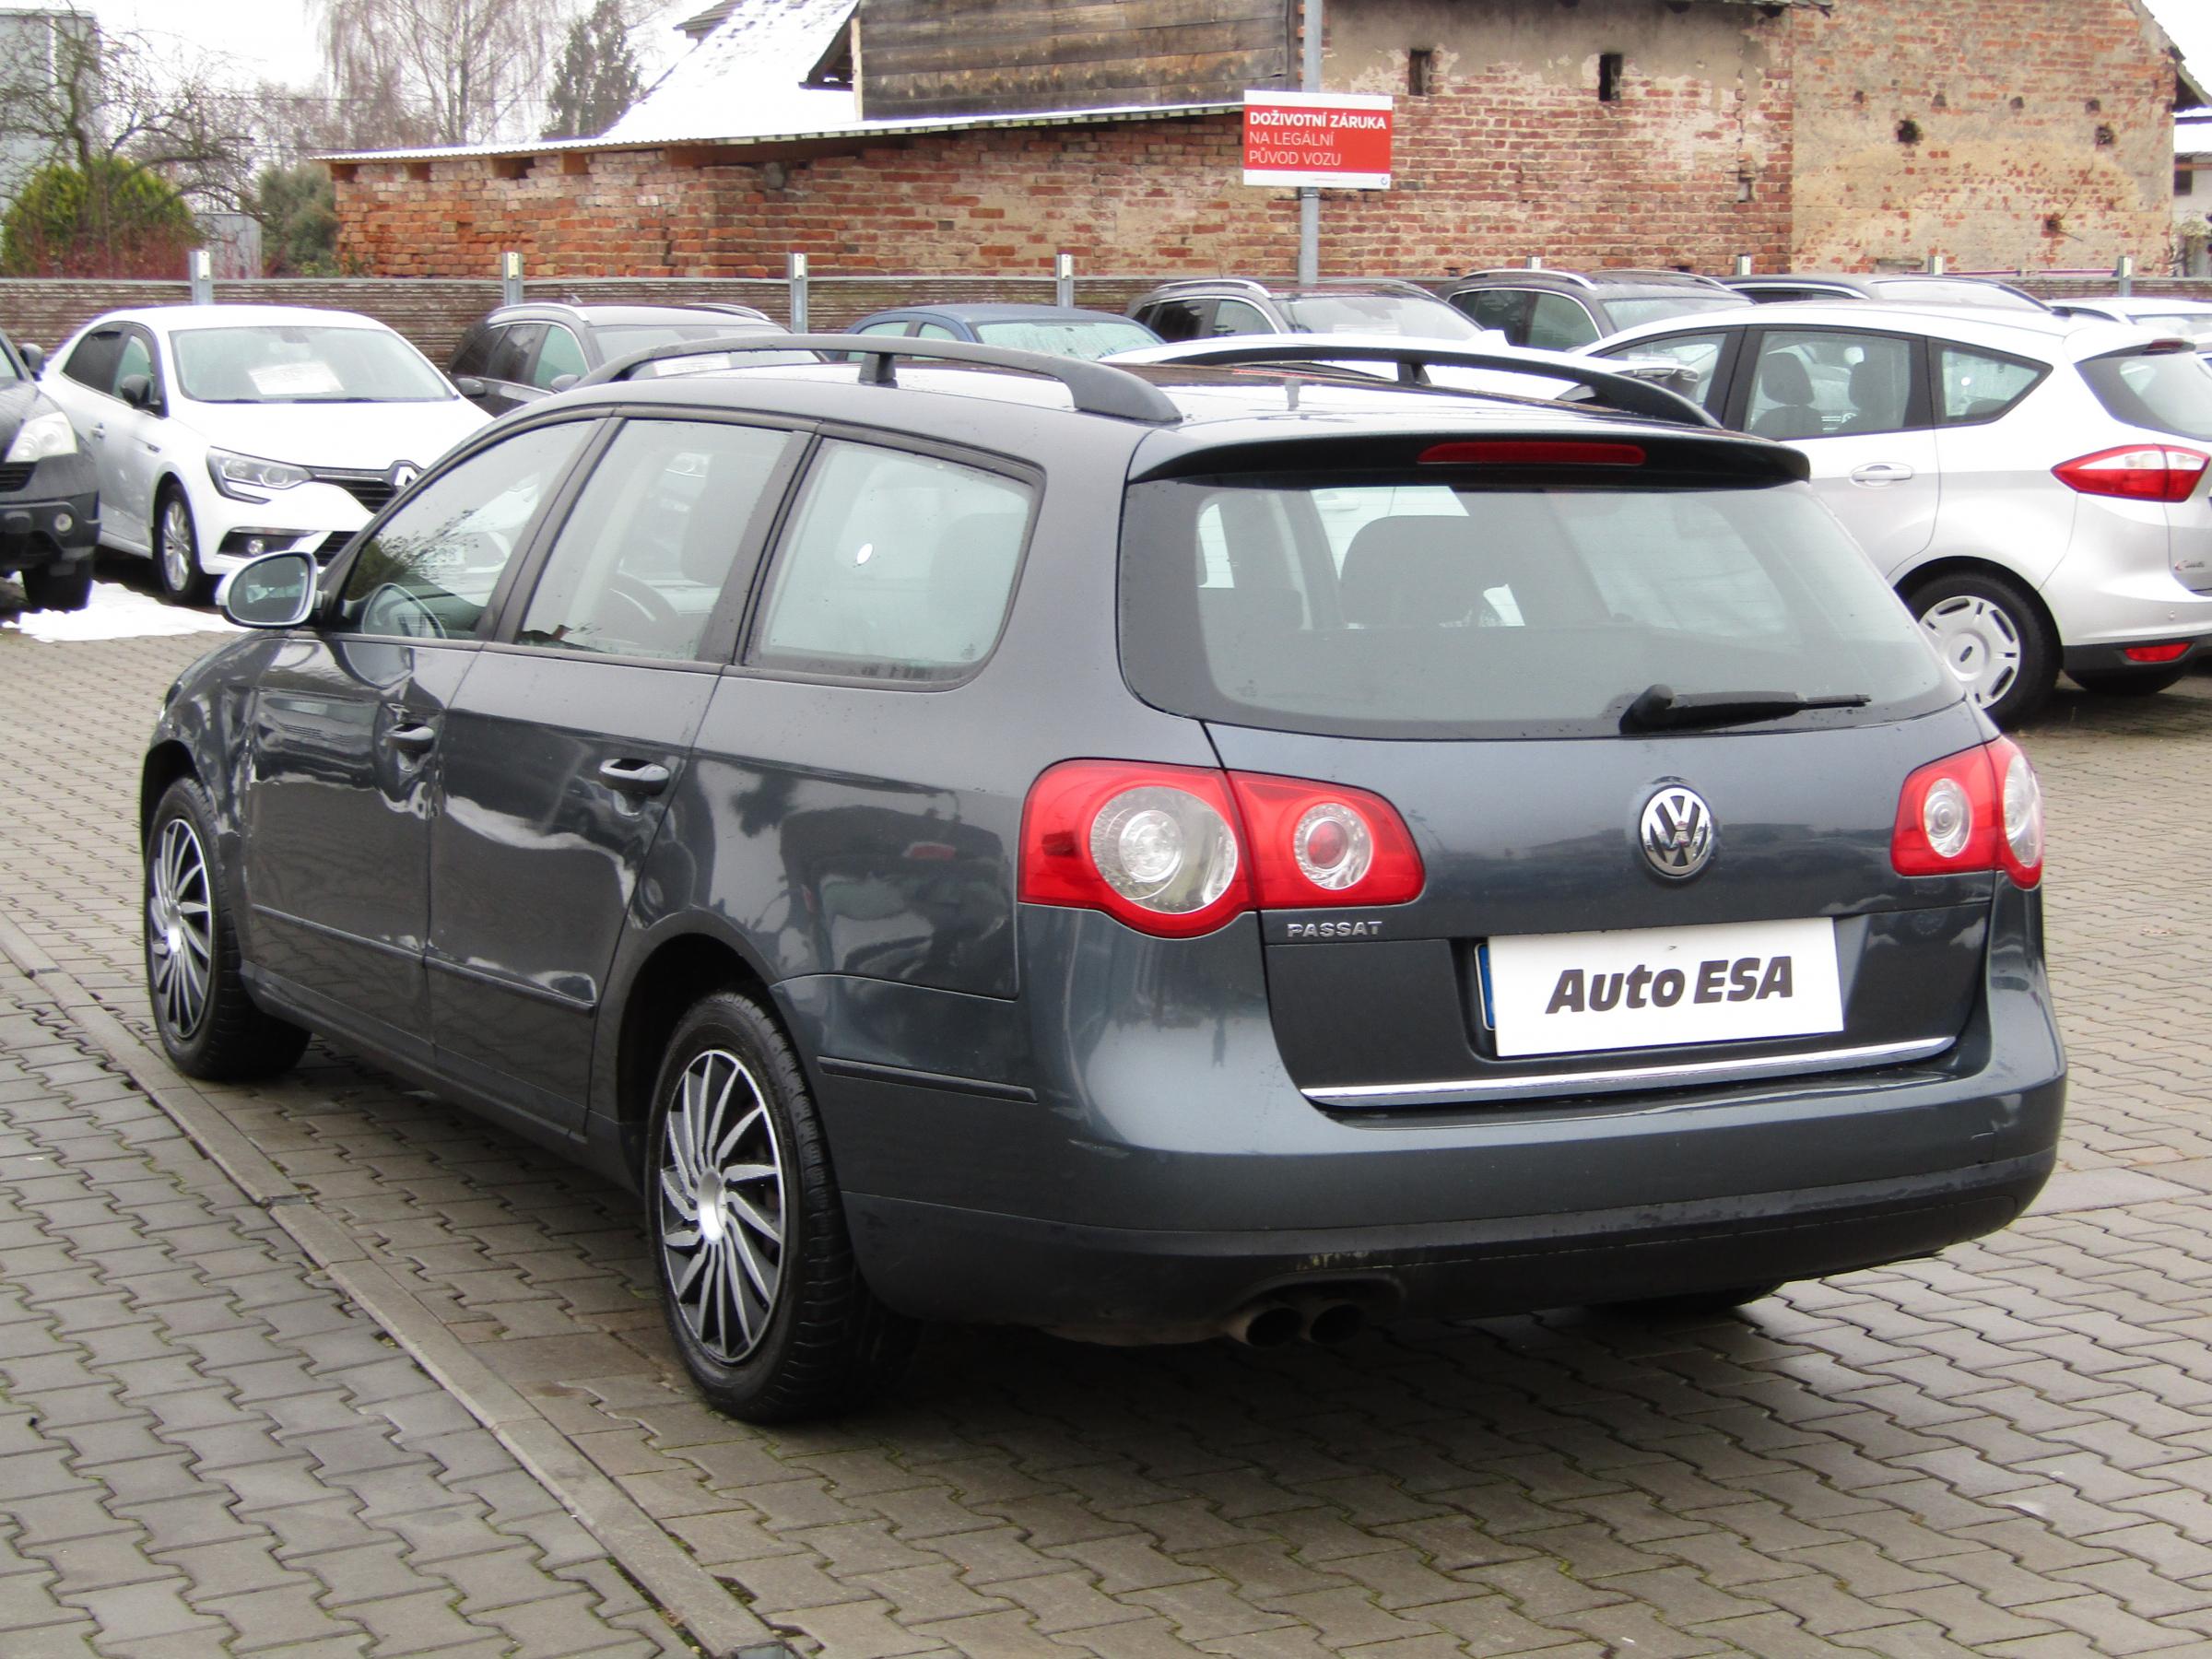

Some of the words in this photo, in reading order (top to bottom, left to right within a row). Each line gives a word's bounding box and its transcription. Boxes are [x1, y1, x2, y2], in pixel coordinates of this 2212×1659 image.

[1249, 110, 1327, 127] DOŽIVOTNÍ
[1329, 112, 1387, 130] ZÁRUKA
[1249, 132, 1270, 145] NA
[1274, 131, 1335, 147] LEGÁLNÍ
[1249, 147, 1299, 165] PŮVOD
[1302, 152, 1342, 166] VOZU
[1287, 921, 1382, 937] PASSAT
[1545, 963, 1686, 1014] Auto
[1693, 956, 1794, 1005] ESA
